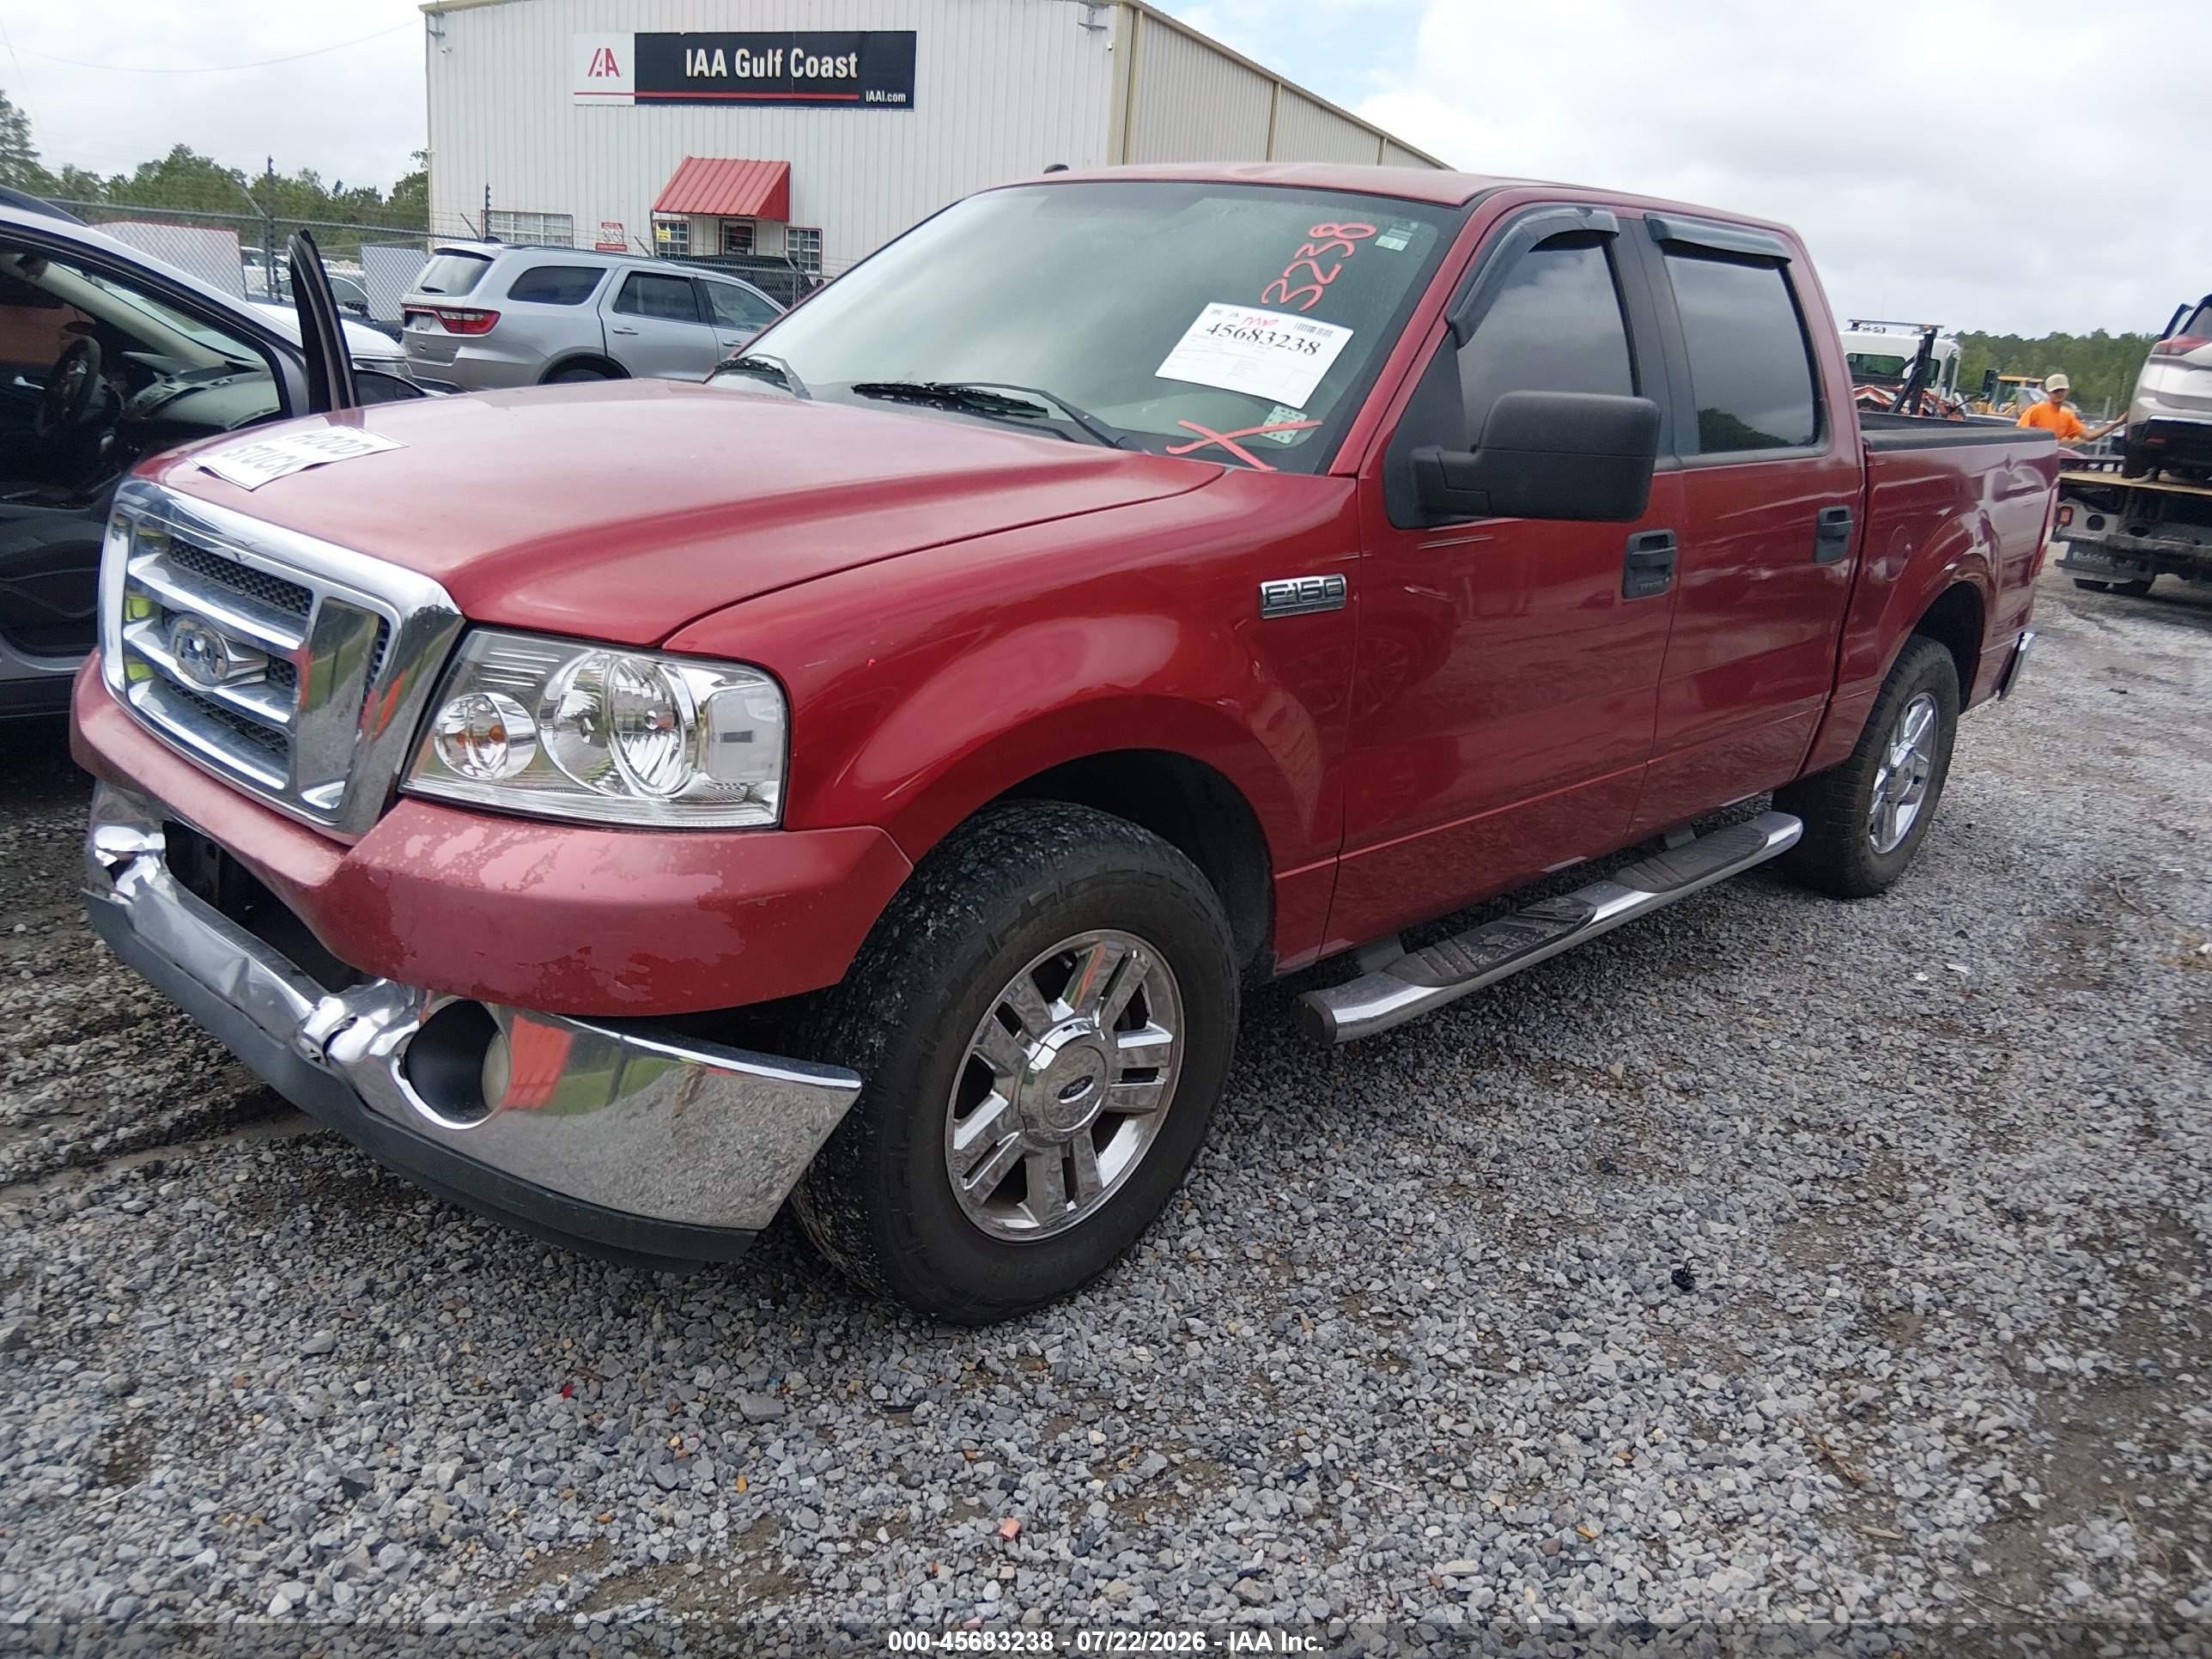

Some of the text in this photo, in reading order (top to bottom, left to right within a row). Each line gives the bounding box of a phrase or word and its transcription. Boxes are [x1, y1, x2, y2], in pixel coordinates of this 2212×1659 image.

[685, 48, 858, 79] IAA Gulf Coast
[865, 89, 907, 104] IAAI.com
[1261, 223, 1376, 312] 3238
[1206, 322, 1322, 356] 45683238
